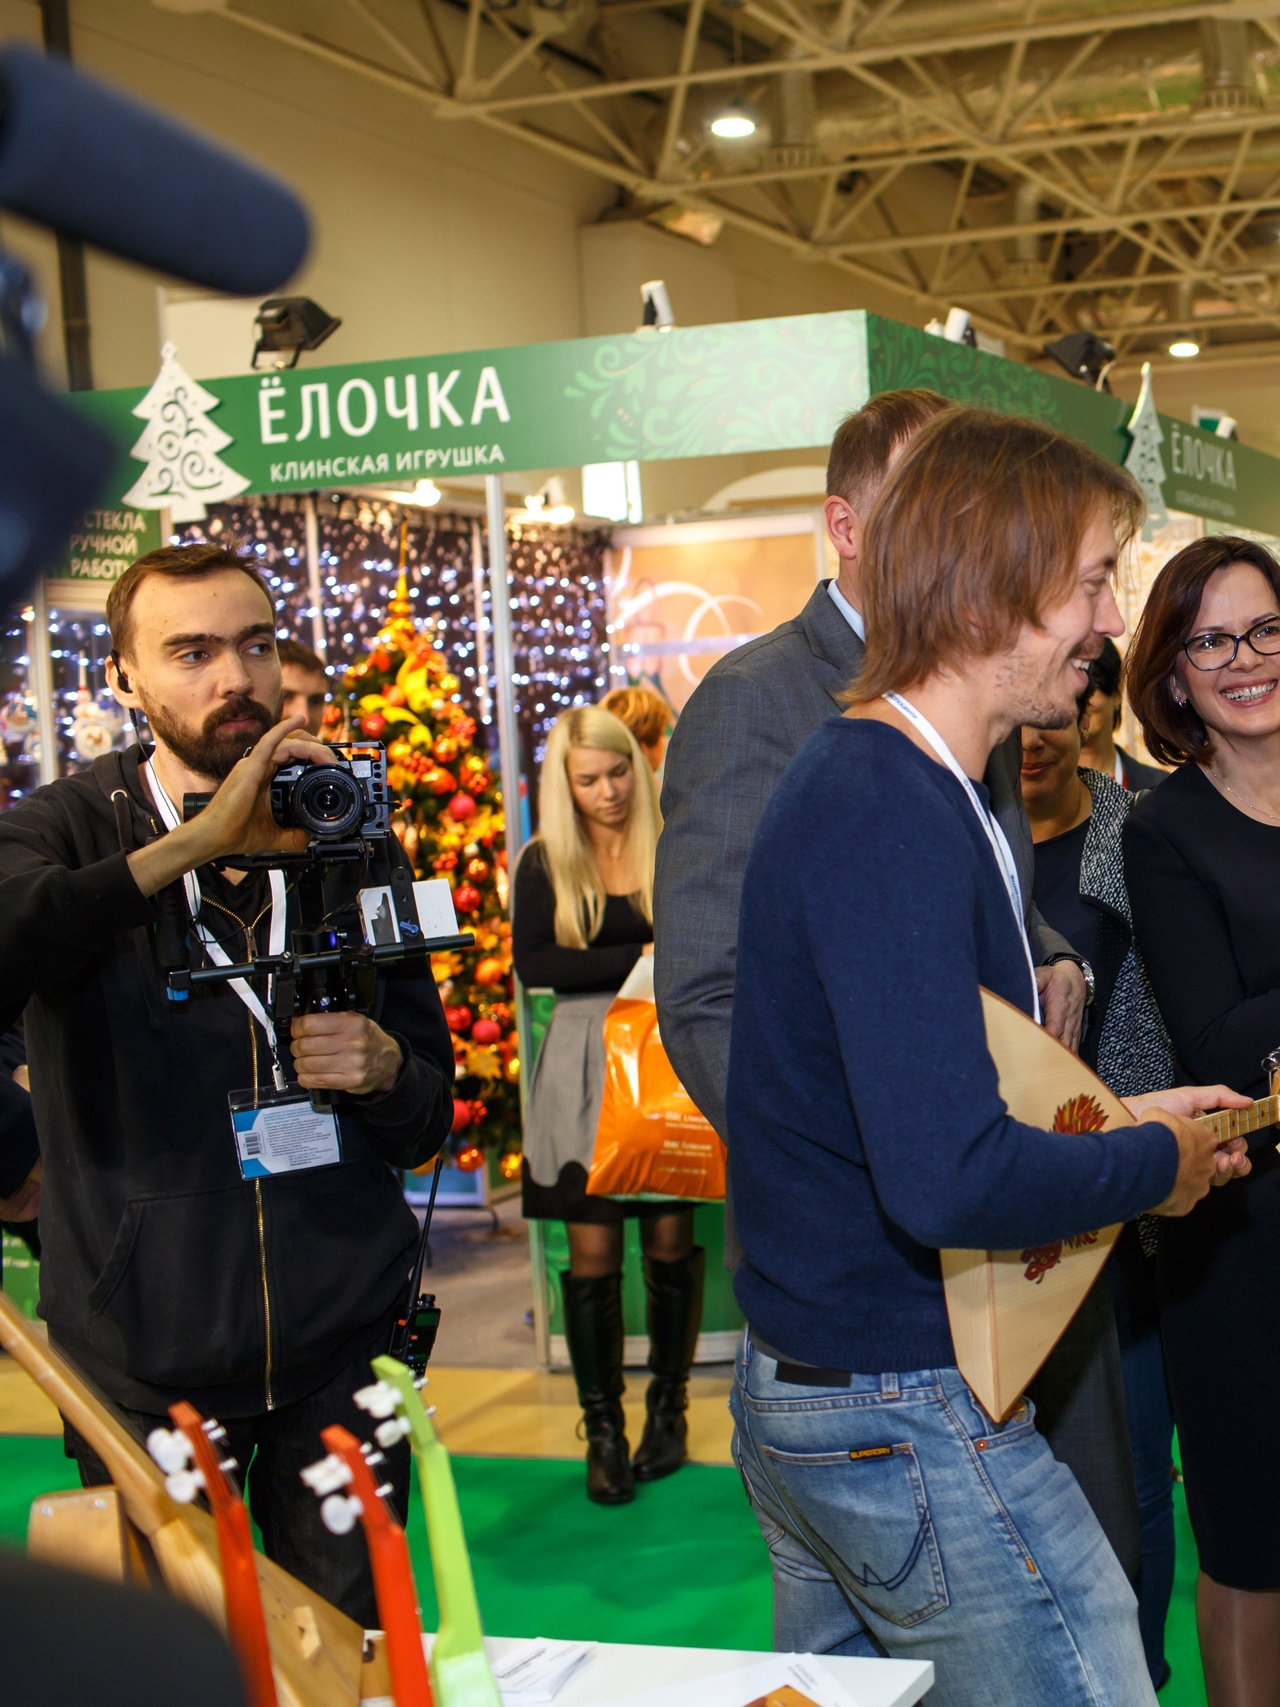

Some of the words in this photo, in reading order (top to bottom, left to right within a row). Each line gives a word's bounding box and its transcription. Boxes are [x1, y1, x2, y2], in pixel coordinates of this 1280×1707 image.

[258, 366, 511, 445] ЁЛОЧКА
[270, 452, 389, 483] КЛИНСКАЯ
[396, 443, 505, 471] ИГРУШКА
[1171, 422, 1237, 491] ЁЛОЧКА
[69, 532, 138, 556] РУЧНОЙ
